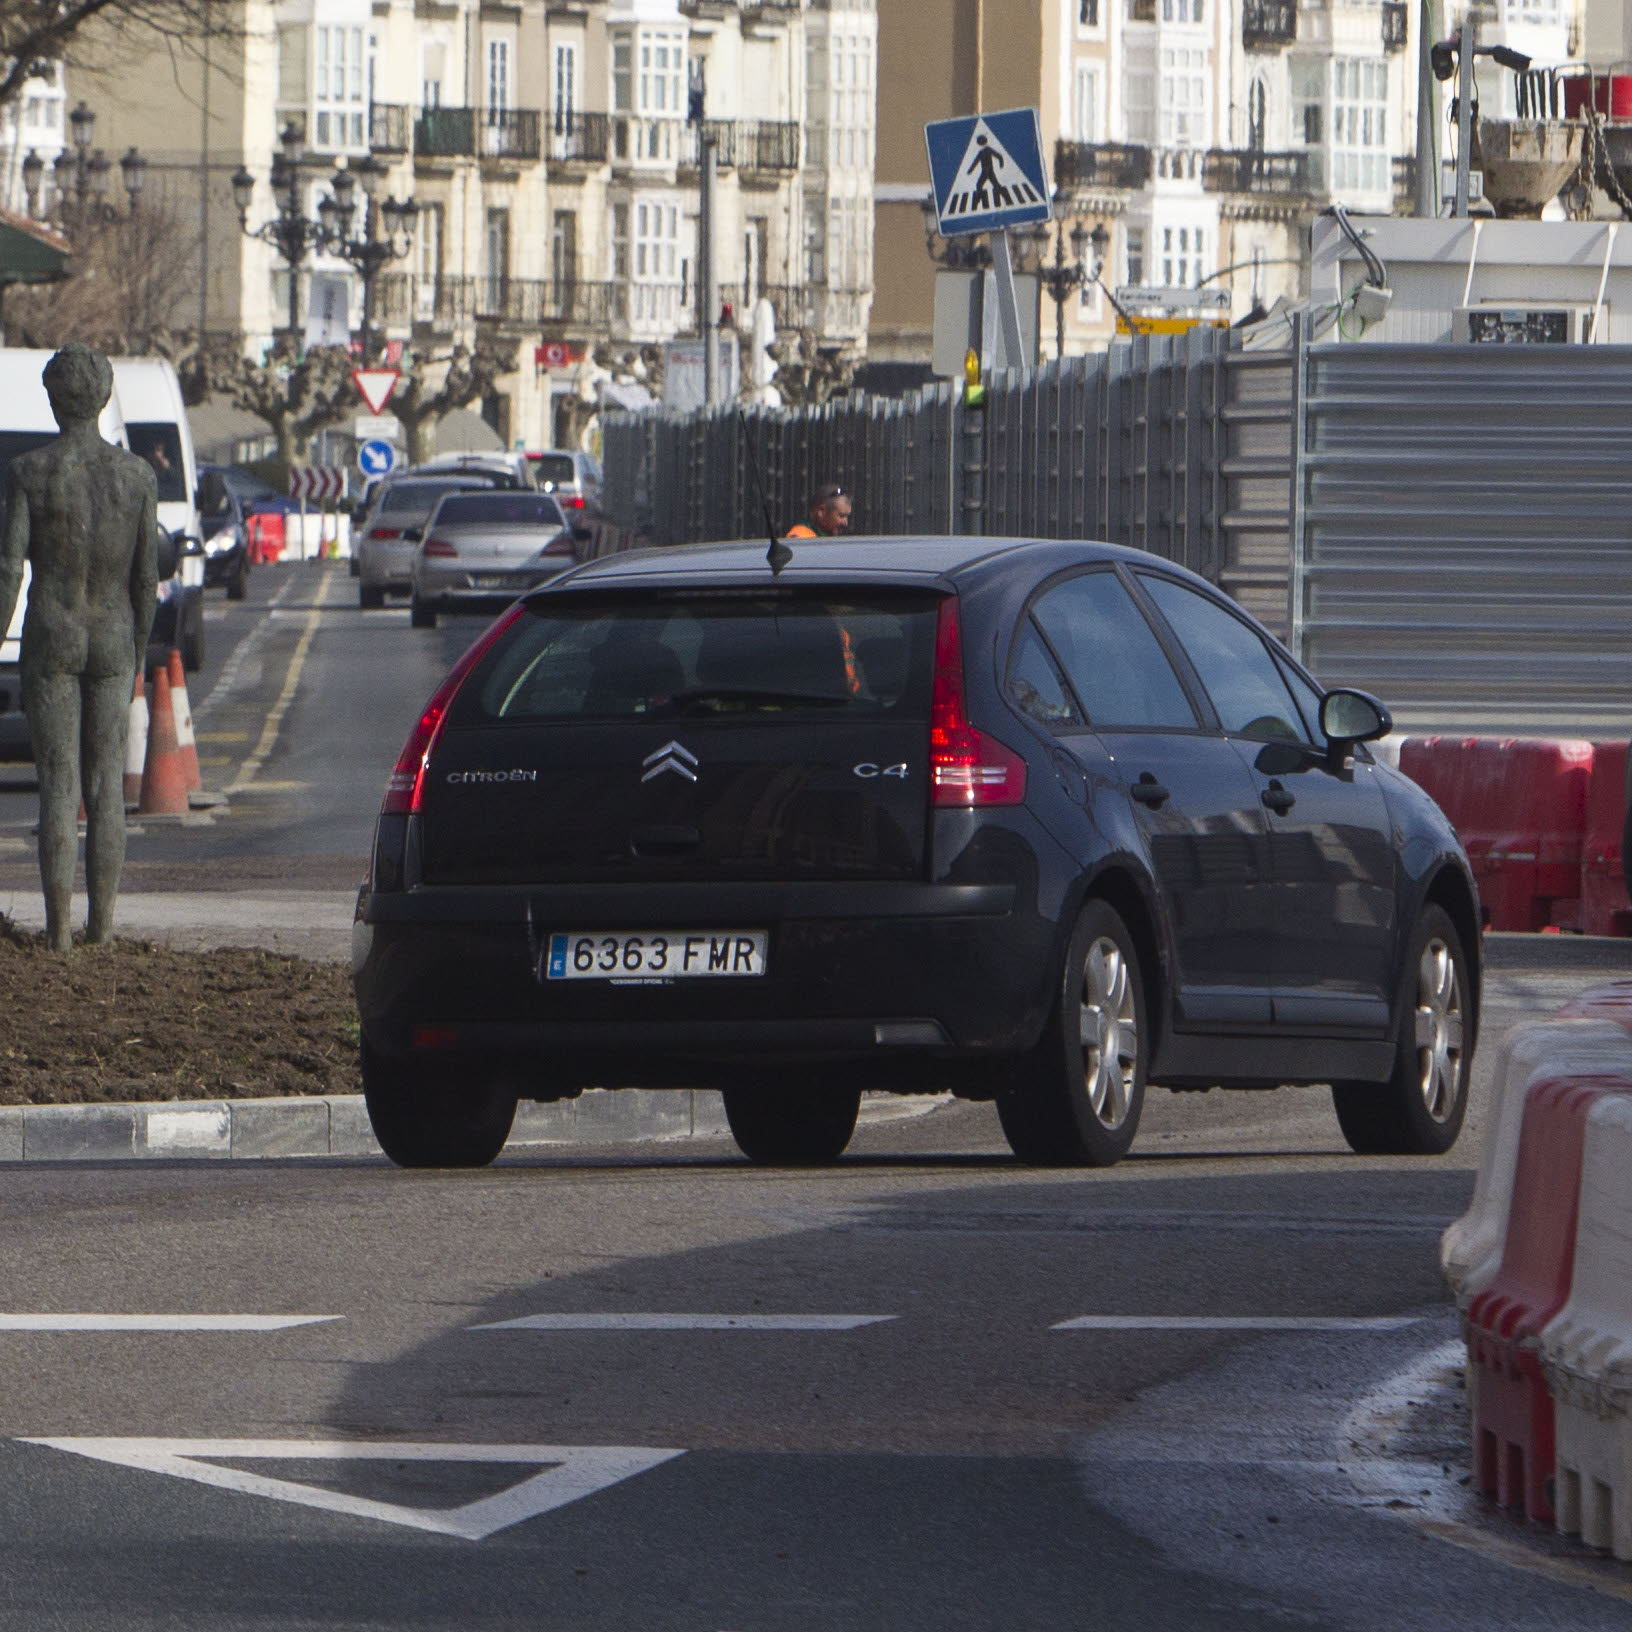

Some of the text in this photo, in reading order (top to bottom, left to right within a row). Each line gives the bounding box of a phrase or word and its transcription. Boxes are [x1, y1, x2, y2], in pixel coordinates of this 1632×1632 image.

[853, 762, 910, 779] C4
[573, 937, 669, 972] 6363
[682, 936, 755, 972] FMR
